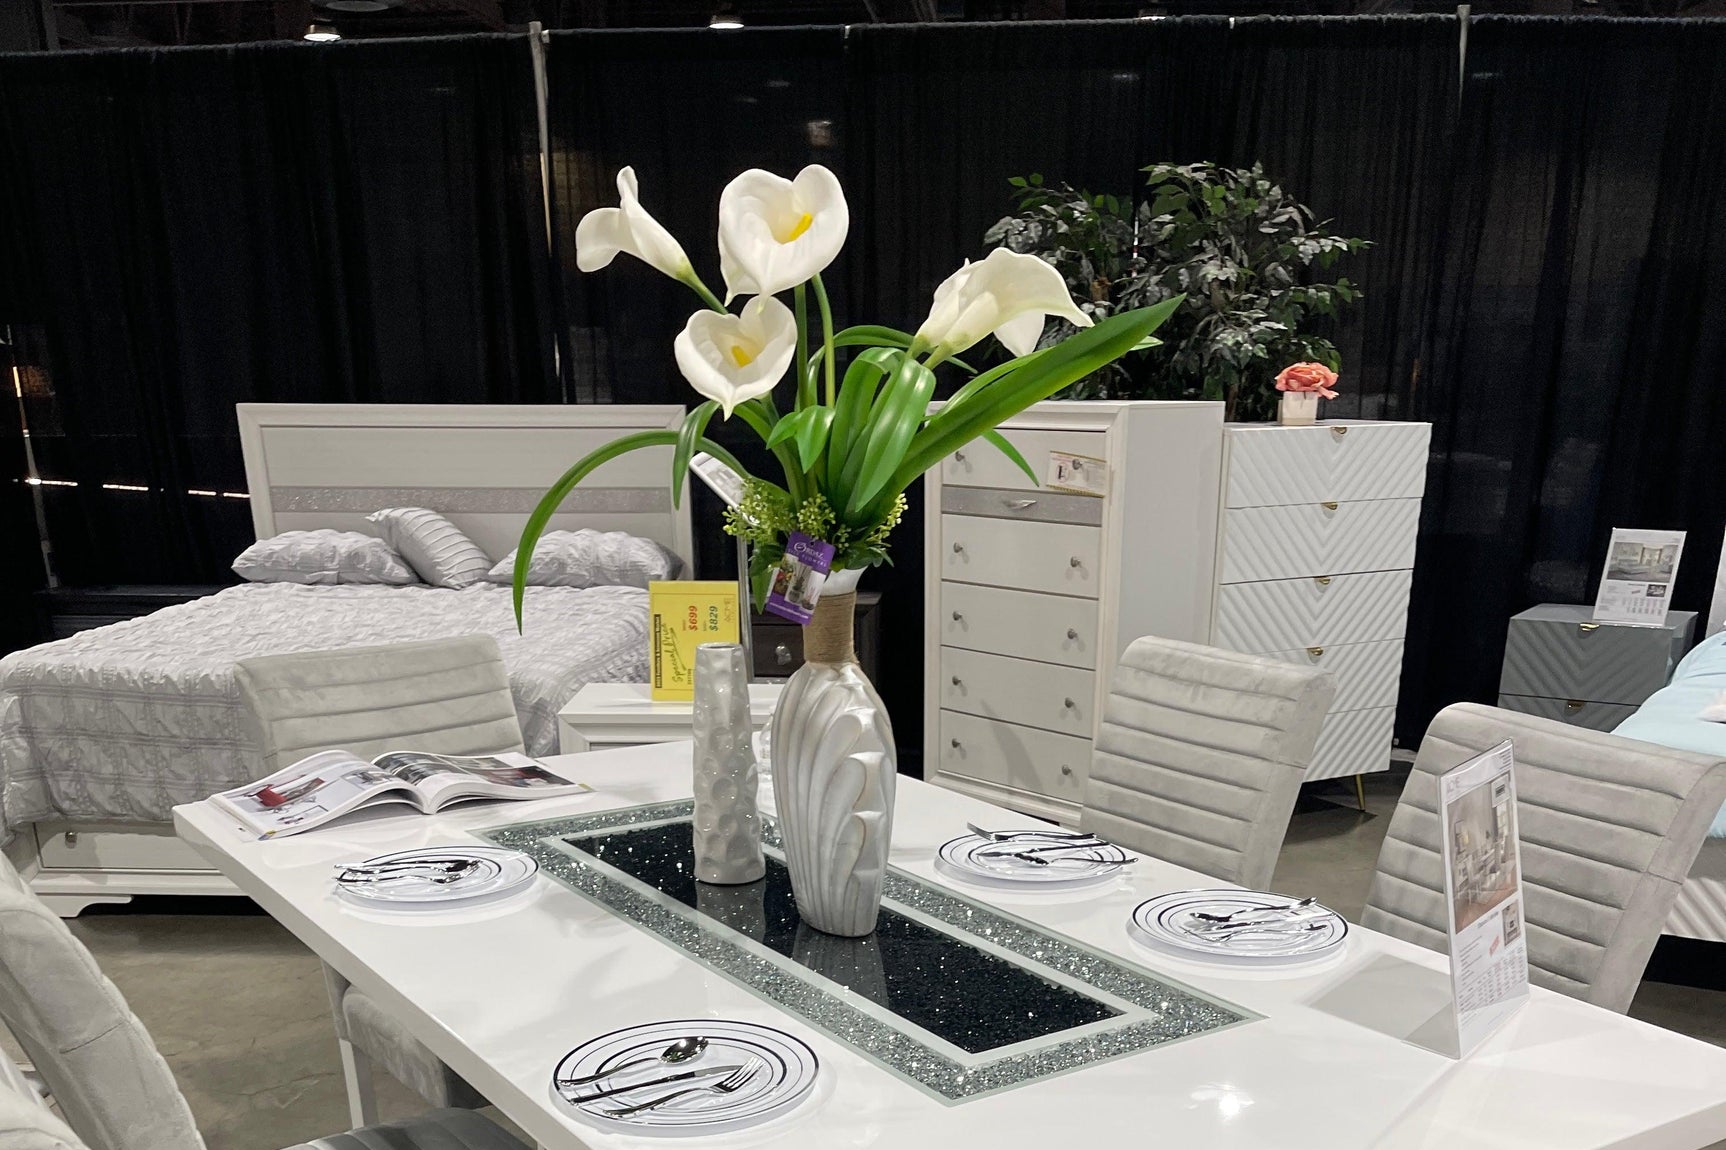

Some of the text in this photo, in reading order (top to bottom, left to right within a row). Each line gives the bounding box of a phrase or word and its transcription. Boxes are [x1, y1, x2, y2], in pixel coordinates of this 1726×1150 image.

[688, 605, 698, 632] $699
[709, 605, 719, 632] $829
[664, 648, 686, 683] Special
